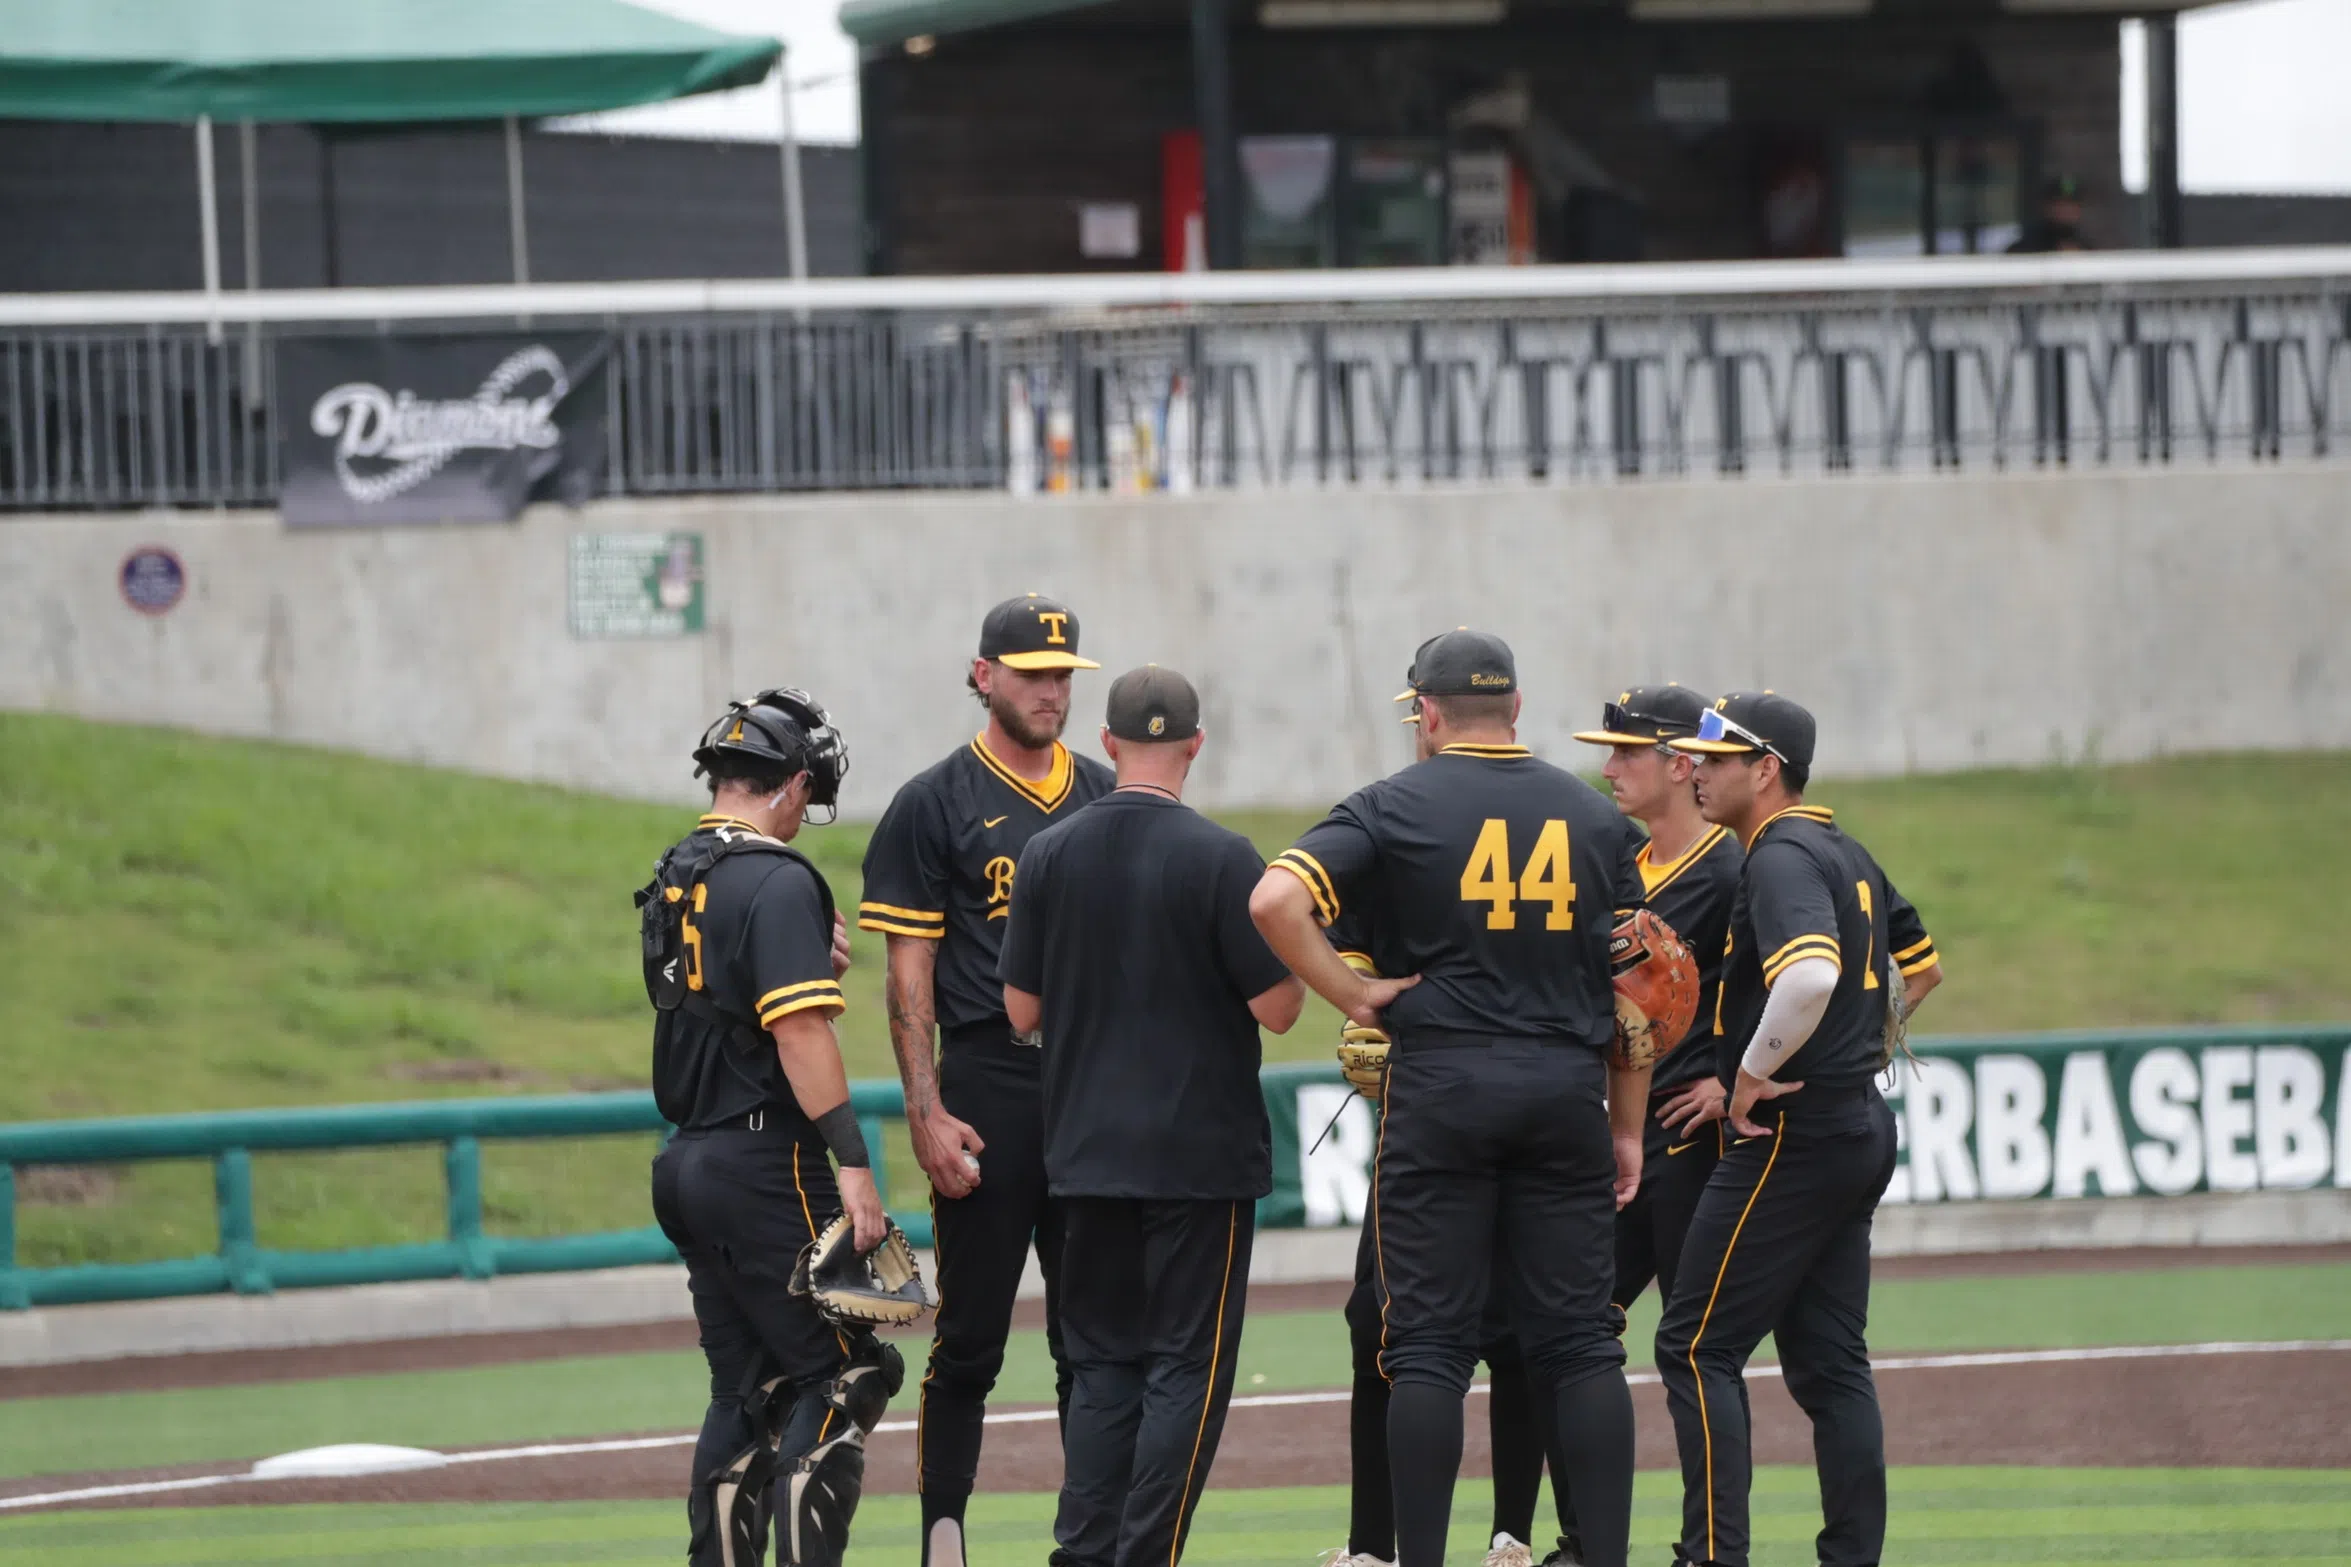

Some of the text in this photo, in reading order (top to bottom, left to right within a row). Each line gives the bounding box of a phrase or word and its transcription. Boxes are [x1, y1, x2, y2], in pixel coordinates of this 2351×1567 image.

[1038, 612, 1067, 644] T
[1460, 818, 1576, 931] 44
[1875, 1045, 2351, 1203] RBASEB
